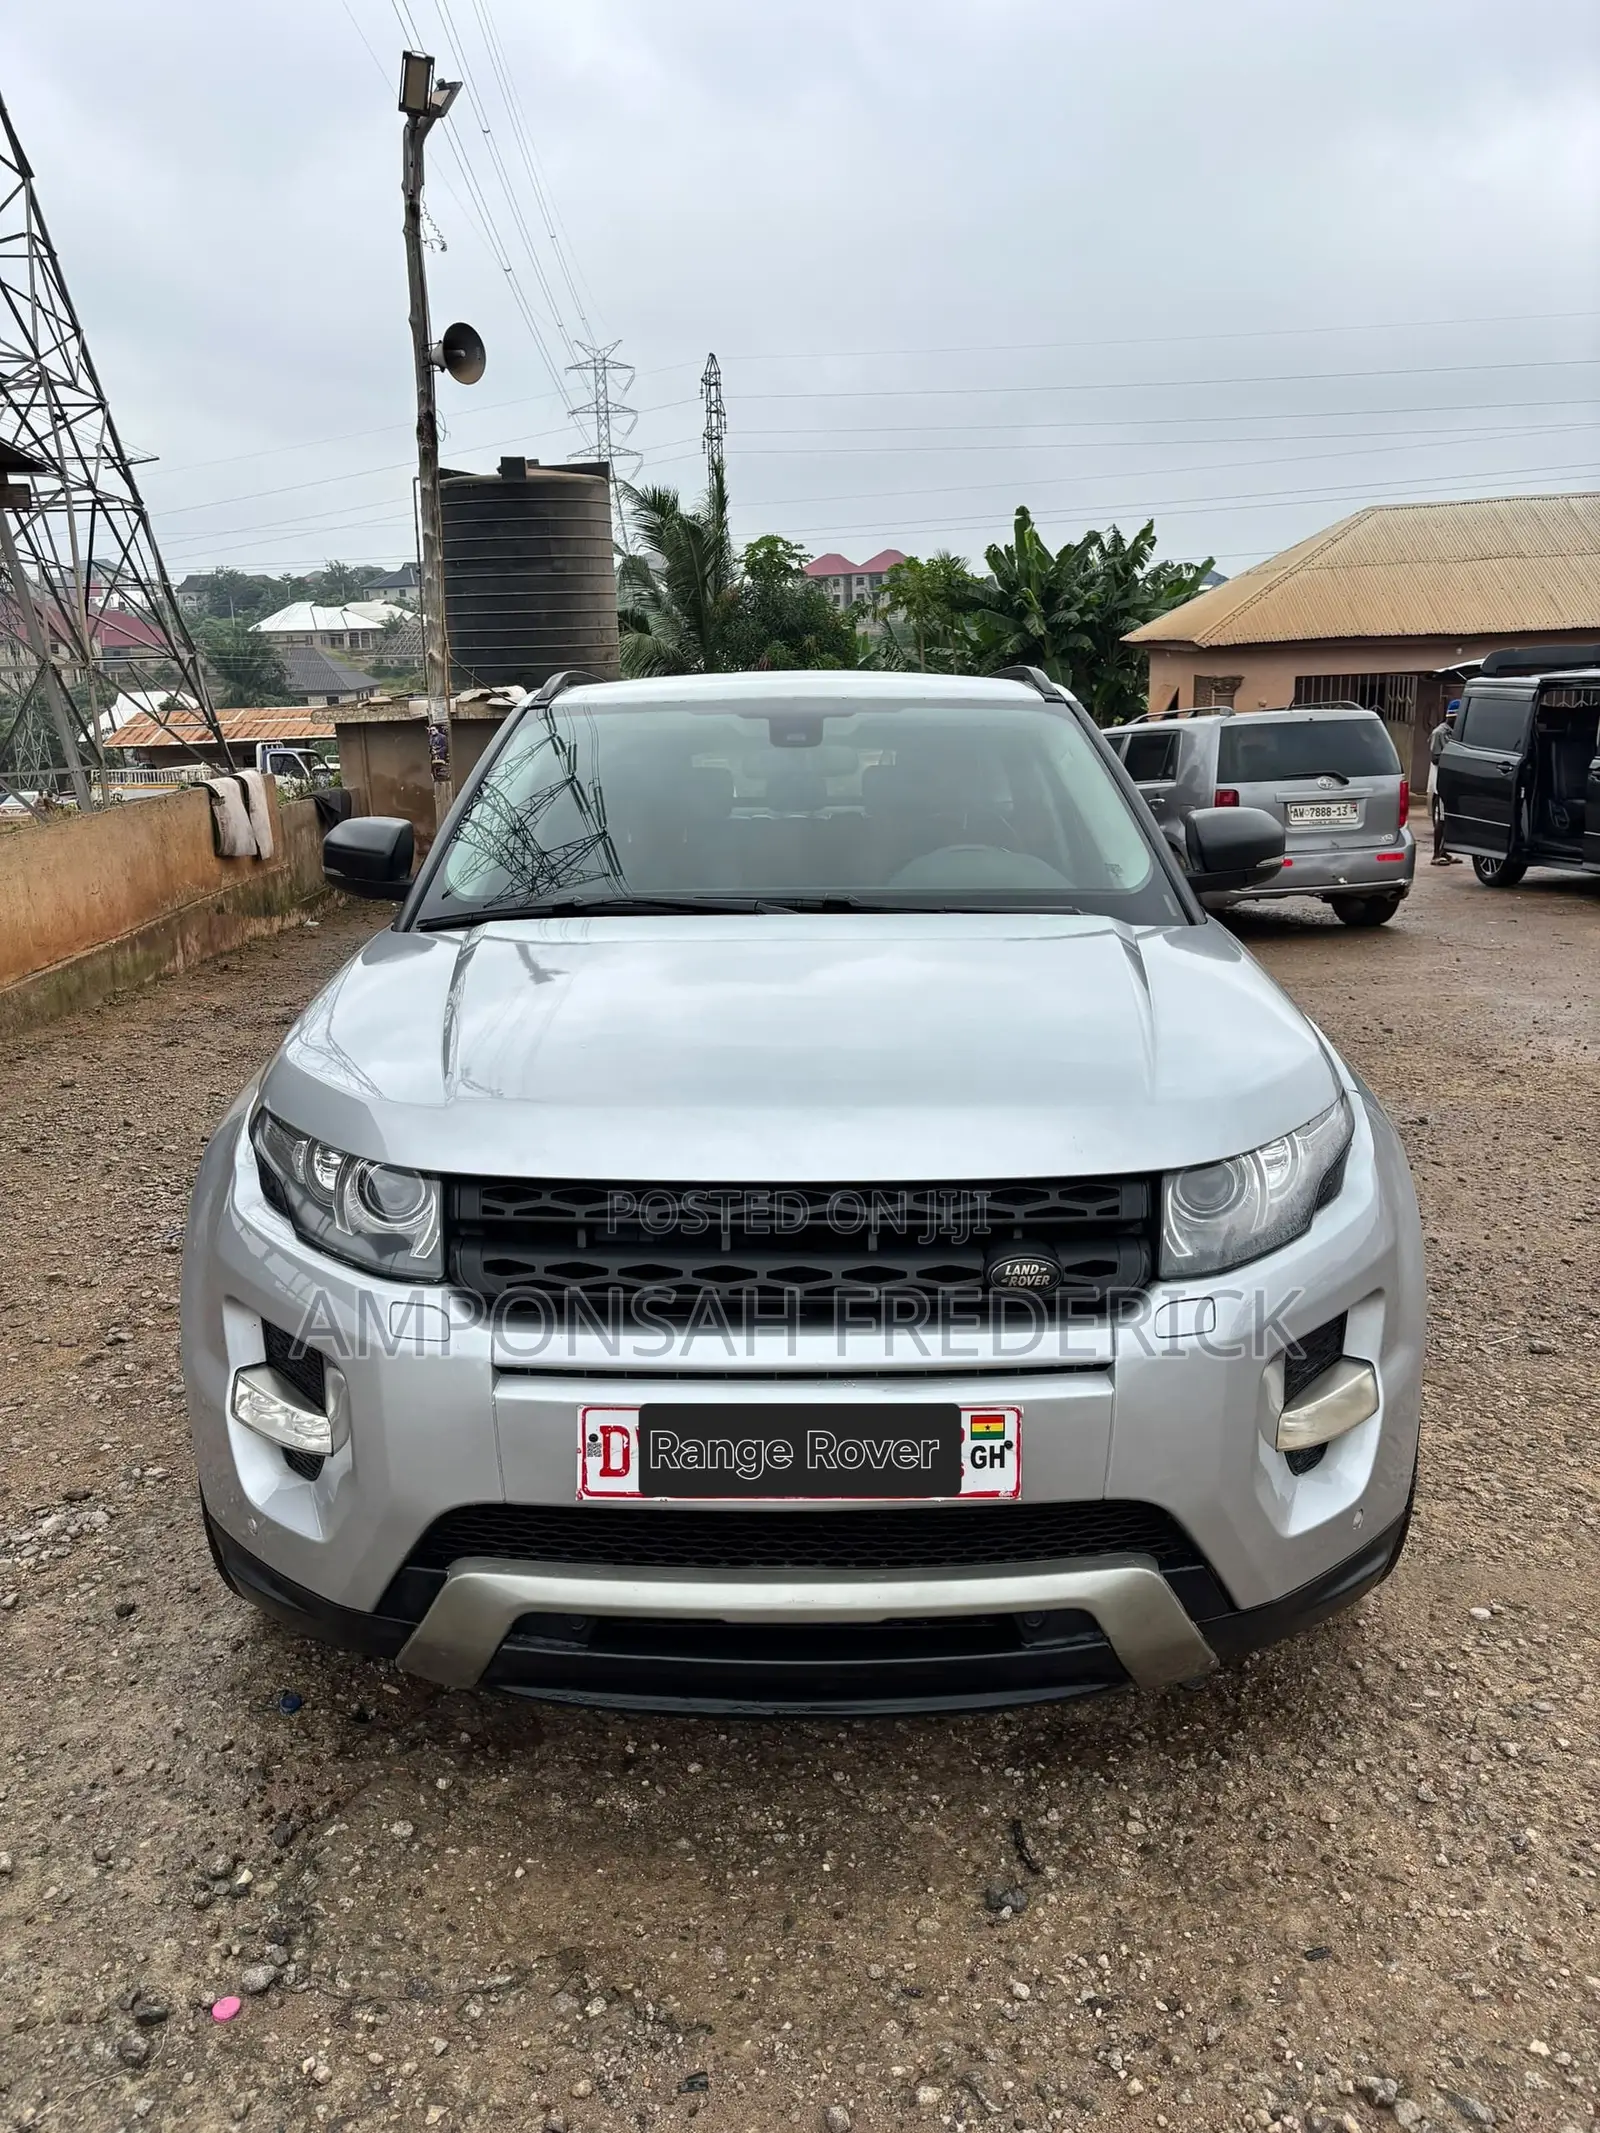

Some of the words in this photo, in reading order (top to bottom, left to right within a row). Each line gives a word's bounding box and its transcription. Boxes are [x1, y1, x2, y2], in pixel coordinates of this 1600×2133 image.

[1005, 1264, 1039, 1275] LAND
[1008, 1275, 1050, 1287] ROVER
[599, 1425, 638, 1477] D
[970, 1445, 1005, 1469] GH
